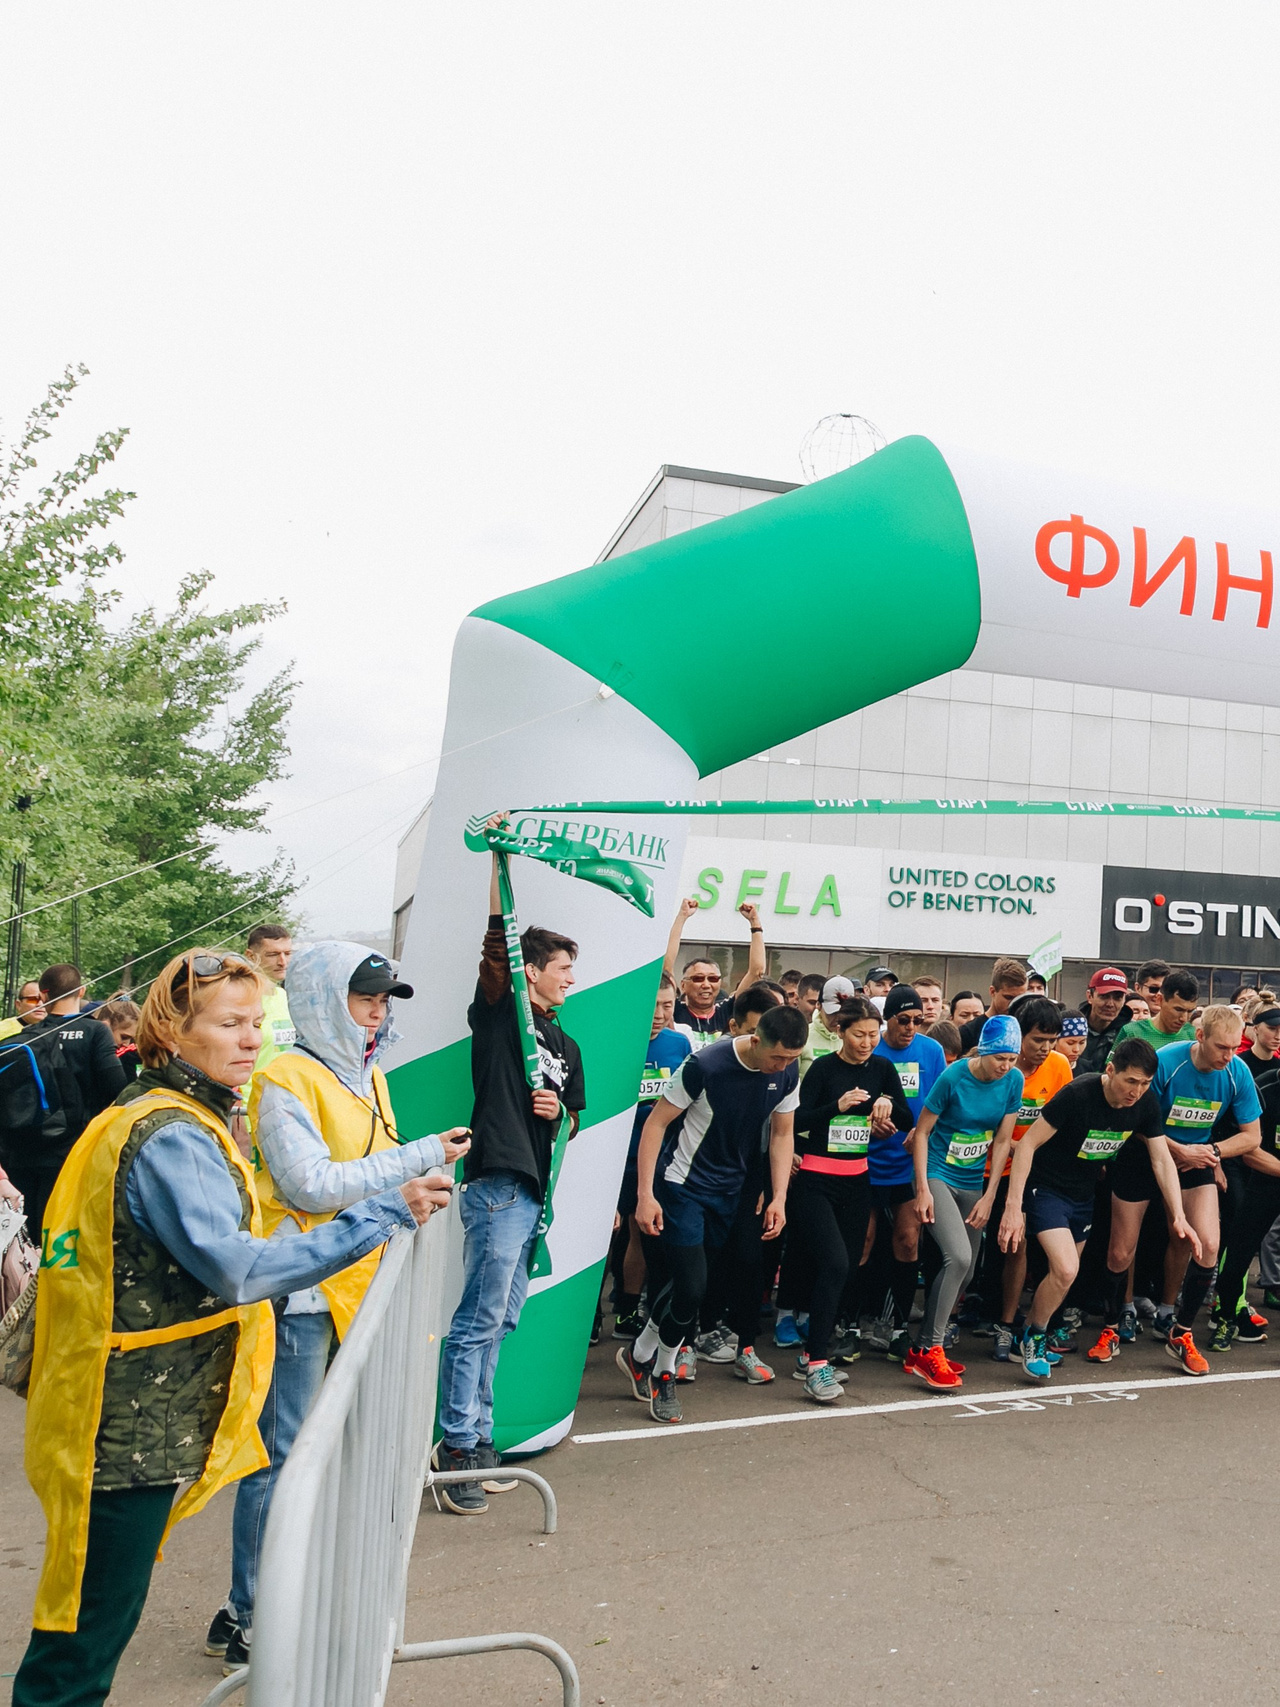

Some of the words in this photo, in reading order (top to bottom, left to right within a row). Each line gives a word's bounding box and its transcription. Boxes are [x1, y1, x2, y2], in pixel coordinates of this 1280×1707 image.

[935, 799, 988, 809] СТАРТ
[1065, 801, 1115, 812] СТАРТ
[1173, 805, 1221, 816] СТАРТ
[515, 817, 670, 863] СБЕРБАНК
[889, 866, 968, 888] UNITED
[974, 871, 1056, 893] COLORS
[692, 867, 842, 917] SELA
[888, 890, 917, 909] OF
[59, 1030, 84, 1041] TER
[902, 1075, 916, 1086] 54
[1018, 1108, 1041, 1118] 340
[1185, 1109, 1214, 1121] 0188
